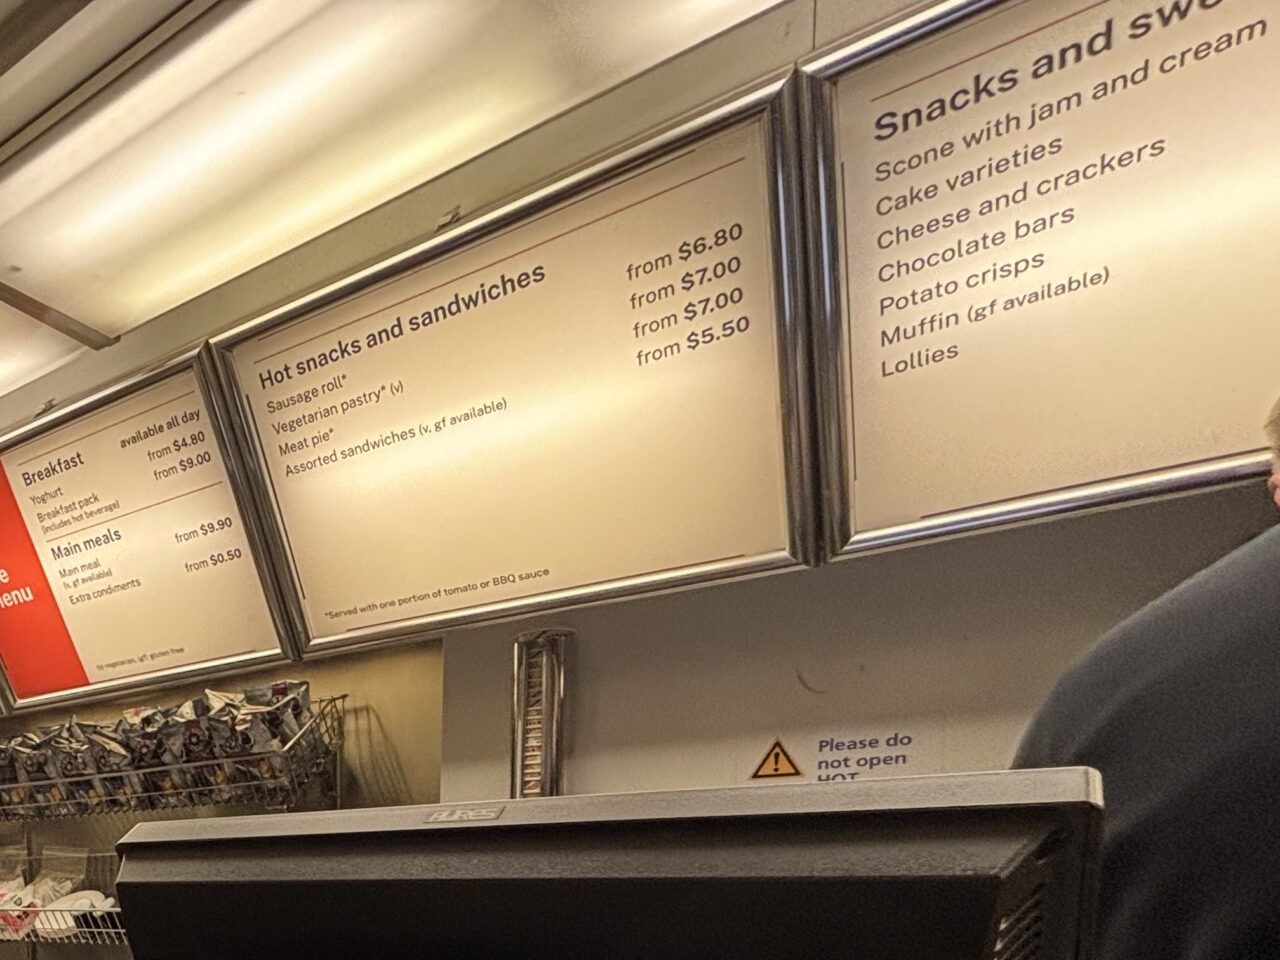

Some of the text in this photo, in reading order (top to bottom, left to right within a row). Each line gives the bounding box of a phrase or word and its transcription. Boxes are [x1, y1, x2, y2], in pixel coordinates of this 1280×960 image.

[873, 67, 1019, 142] Snacks
[1031, 19, 1114, 80] and
[875, 19, 1268, 182] Scone with jam and cream
[875, 136, 1063, 216] Cake varieties
[877, 136, 1167, 250] Cheese and crackers
[626, 223, 743, 281] from $6.80
[877, 206, 1076, 283] Chocolate bars
[629, 256, 742, 310] from $7.00
[880, 251, 1046, 316] Potato crisps
[632, 287, 743, 339] from $7.00
[880, 266, 1111, 347] Muffin (gf available)
[258, 263, 547, 390] Hot snacks and sandwiches
[636, 316, 750, 367] from $5.50
[881, 343, 960, 377] Lollies
[266, 386, 320, 415] Sausage
[271, 404, 338, 435] Vegetarian
[390, 380, 404, 397] (v)
[120, 408, 201, 449] available all day
[147, 431, 206, 461] from $4.80
[278, 436, 310, 457] Meat
[284, 449, 338, 478] Assorted
[340, 427, 416, 460] sandwiches
[434, 415, 448, 433] gf
[450, 397, 508, 426] available)
[21, 452, 85, 487] Breakfast
[154, 451, 212, 481] from $9.00
[29, 486, 63, 505] Yoghurt
[37, 492, 100, 523] Breakfast pack
[71, 512, 84, 524] hot
[84, 500, 120, 519] beverage)
[51, 528, 122, 560] Main meals
[174, 516, 233, 544] from $9.90
[59, 558, 101, 579] Main meal
[184, 548, 242, 573] from $0.50
[69, 577, 142, 606] Extra condiments
[360, 603, 379, 614] with
[380, 599, 396, 610] one
[398, 591, 431, 606] portion
[432, 588, 442, 599] of
[443, 582, 478, 597] tomato
[479, 579, 491, 590] or
[492, 573, 516, 587] BBQ
[518, 567, 550, 582] sauce
[818, 732, 912, 753] Please do
[818, 754, 907, 770] not open
